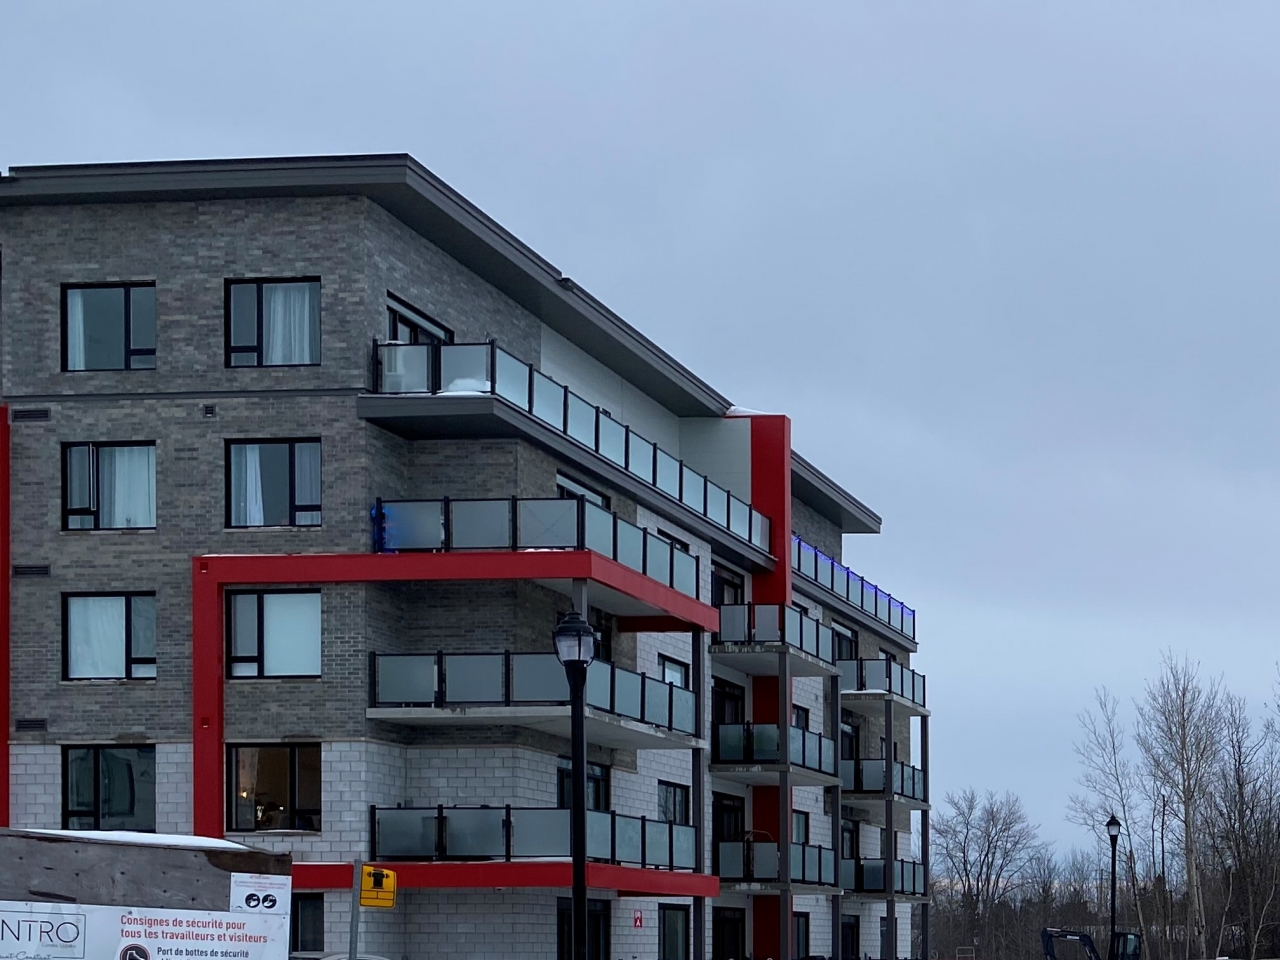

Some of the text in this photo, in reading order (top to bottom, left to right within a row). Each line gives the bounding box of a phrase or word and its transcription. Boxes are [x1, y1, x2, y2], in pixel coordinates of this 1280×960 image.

[120, 914, 246, 930] Consignes de sécurité pour
[121, 929, 268, 943] tous les travailleurs et visiteurs
[157, 947, 249, 958] Port de bottes de sécurité
